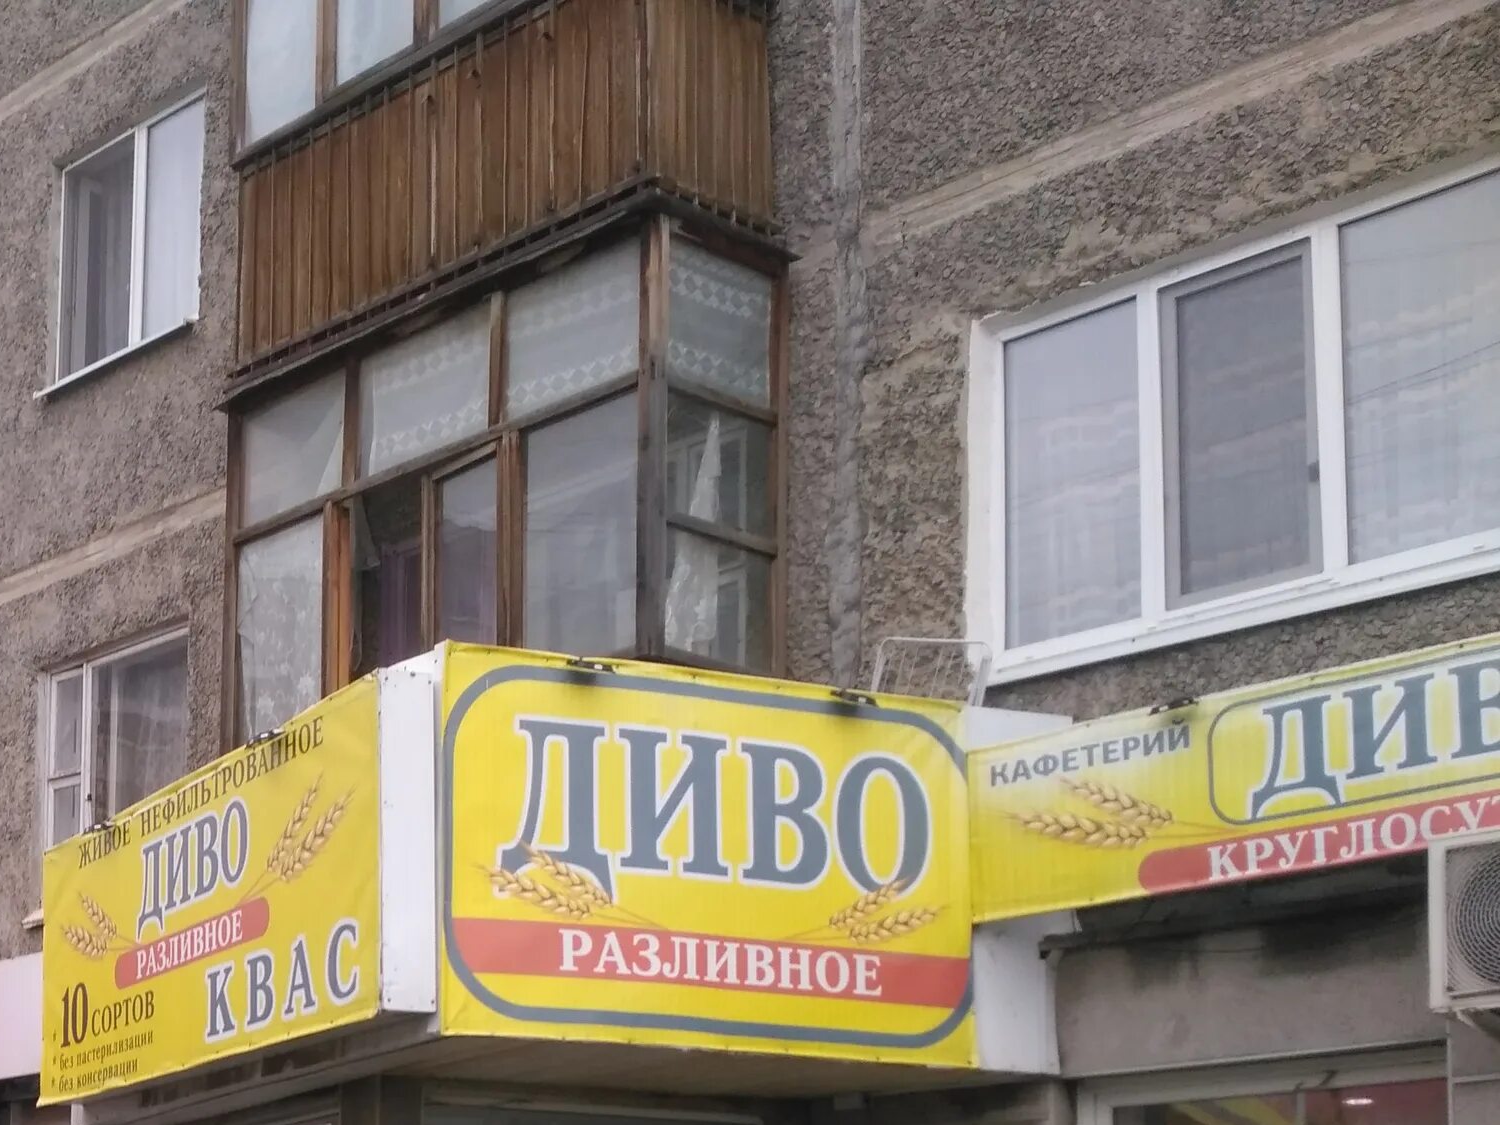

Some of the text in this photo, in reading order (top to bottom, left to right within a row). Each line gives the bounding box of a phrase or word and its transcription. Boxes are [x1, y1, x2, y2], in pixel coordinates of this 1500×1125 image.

[989, 719, 1191, 787] КАФЕТЕРИЙ
[78, 715, 324, 869] ЖИВОЕ НЕФИЛЬТРОВАННОЕ
[496, 718, 930, 905] ДИВО
[137, 798, 248, 942] ДИВО
[1207, 794, 1500, 882] КРУГЛОСУ
[136, 910, 243, 980] РАЗЛИВНОЕ
[558, 927, 882, 996] РАЗЛИВНОЕ
[60, 982, 155, 1048] 10 СОРТОВ
[206, 922, 358, 1039] КВАС
[58, 1058, 138, 1094] без консервации
[59, 1029, 154, 1071] без пастерилизации
